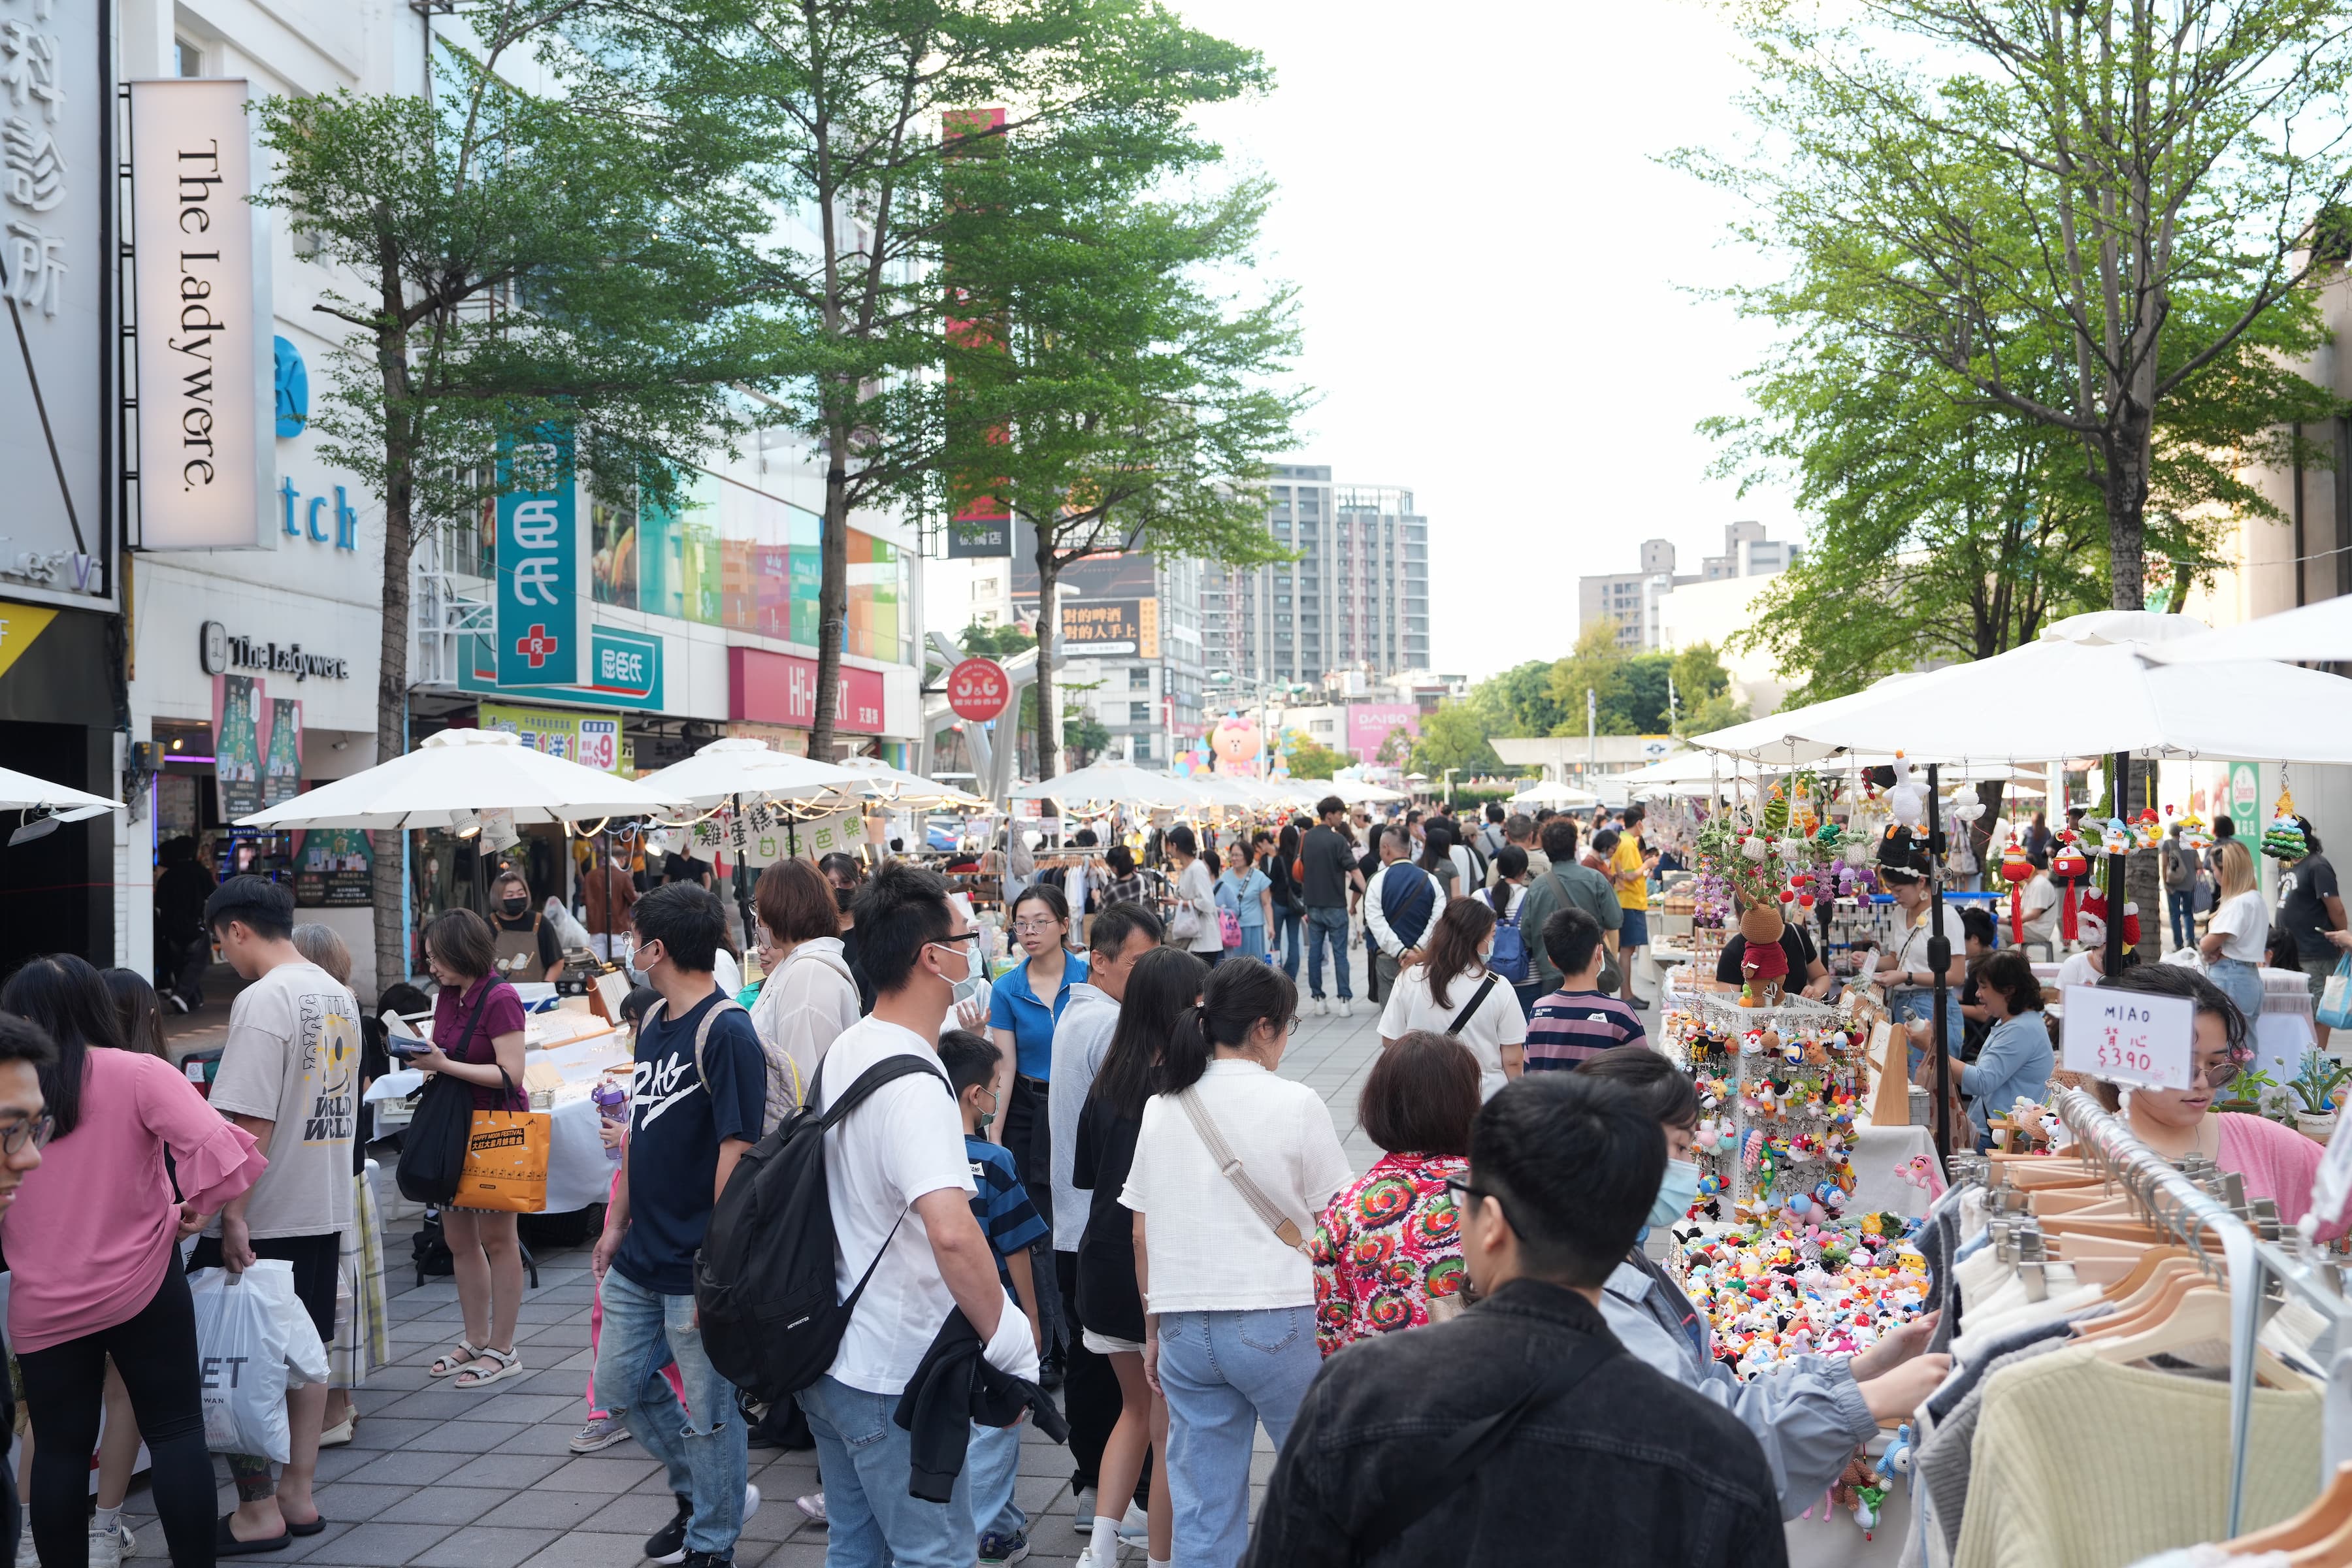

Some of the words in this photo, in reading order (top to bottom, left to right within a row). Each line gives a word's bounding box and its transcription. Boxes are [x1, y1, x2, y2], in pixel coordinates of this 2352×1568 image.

[1, 0, 68, 319] 科診所
[178, 138, 223, 235] The
[169, 250, 226, 493] Ladywere.
[513, 442, 560, 606] 屈臣氏
[1062, 607, 1122, 624] 對的啤酒
[1064, 623, 1137, 640] 對的人手上
[228, 635, 269, 669] The
[267, 642, 350, 681] Ladywere
[601, 648, 643, 683] 屈臣氏
[956, 677, 1000, 697] J&G
[1359, 713, 1408, 725] DAISO
[593, 734, 613, 769] $9
[2104, 1005, 2150, 1022] MIAO
[2104, 1026, 2148, 1048] 背心
[2097, 1045, 2151, 1071] $390
[501, 1129, 523, 1137] FESTIVAL
[201, 1356, 248, 1388] ET
